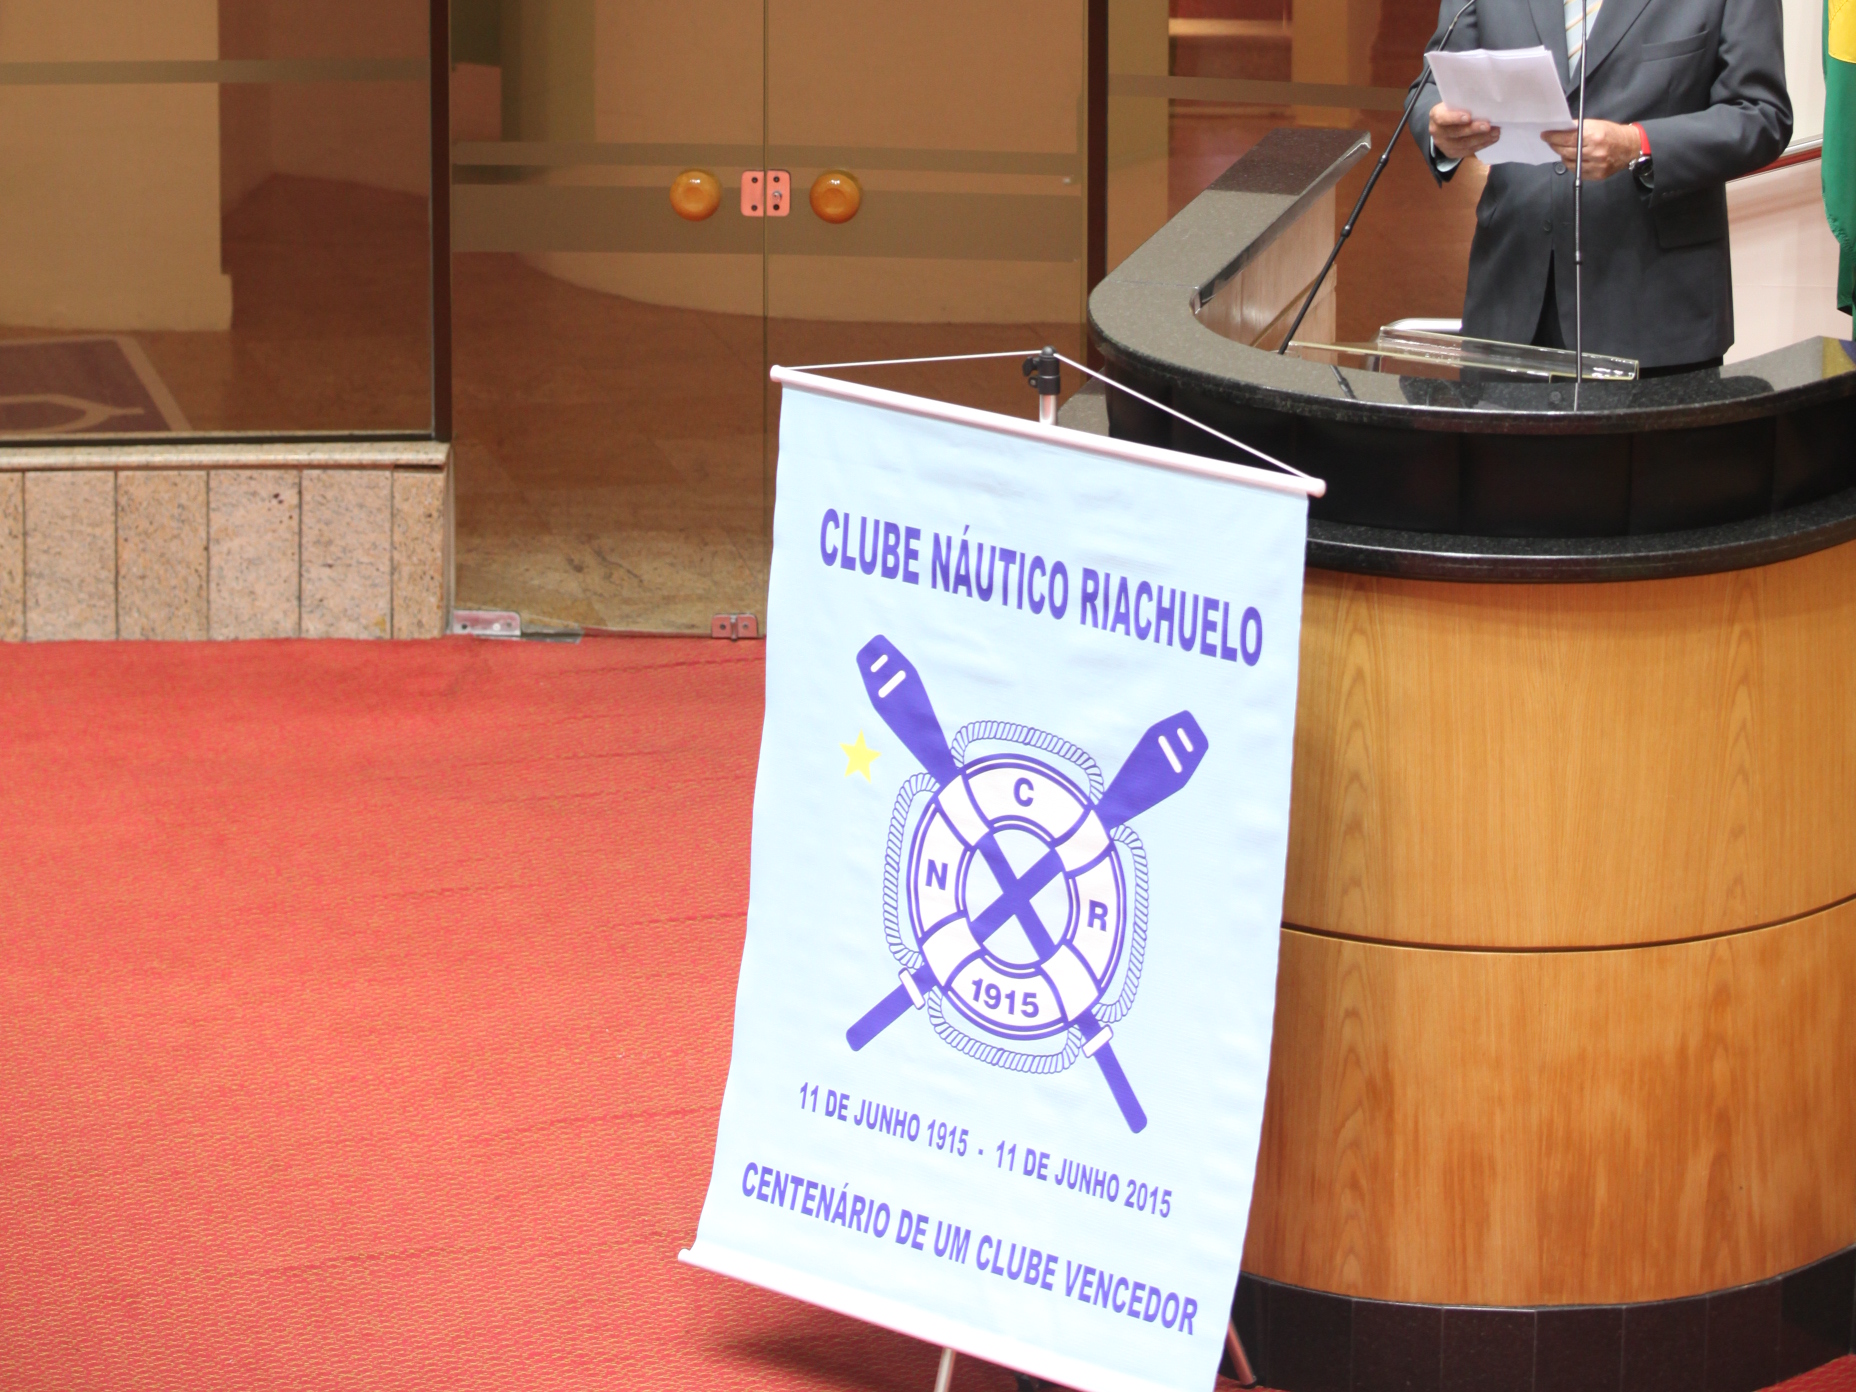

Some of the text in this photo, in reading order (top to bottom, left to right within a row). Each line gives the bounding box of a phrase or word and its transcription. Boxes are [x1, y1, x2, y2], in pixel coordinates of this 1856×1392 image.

[820, 507, 1263, 667] CLUBE NÁUTICO RIACHUELO
[1013, 777, 1034, 807] C
[925, 858, 949, 891] N
[1087, 899, 1109, 931] R
[971, 977, 1040, 1018] 1915
[800, 1081, 819, 1112] 11
[824, 1089, 850, 1121] DE
[853, 1099, 921, 1142] JUNHO
[927, 1119, 969, 1157] 1915
[996, 1140, 1017, 1171] 11
[1023, 1147, 1051, 1181] DE
[1054, 1158, 1120, 1202] JUNHO
[1124, 1178, 1172, 1218] 2015
[742, 1161, 1198, 1335] CENTENÁRIO DE UM CLUBE VENCEDOR
